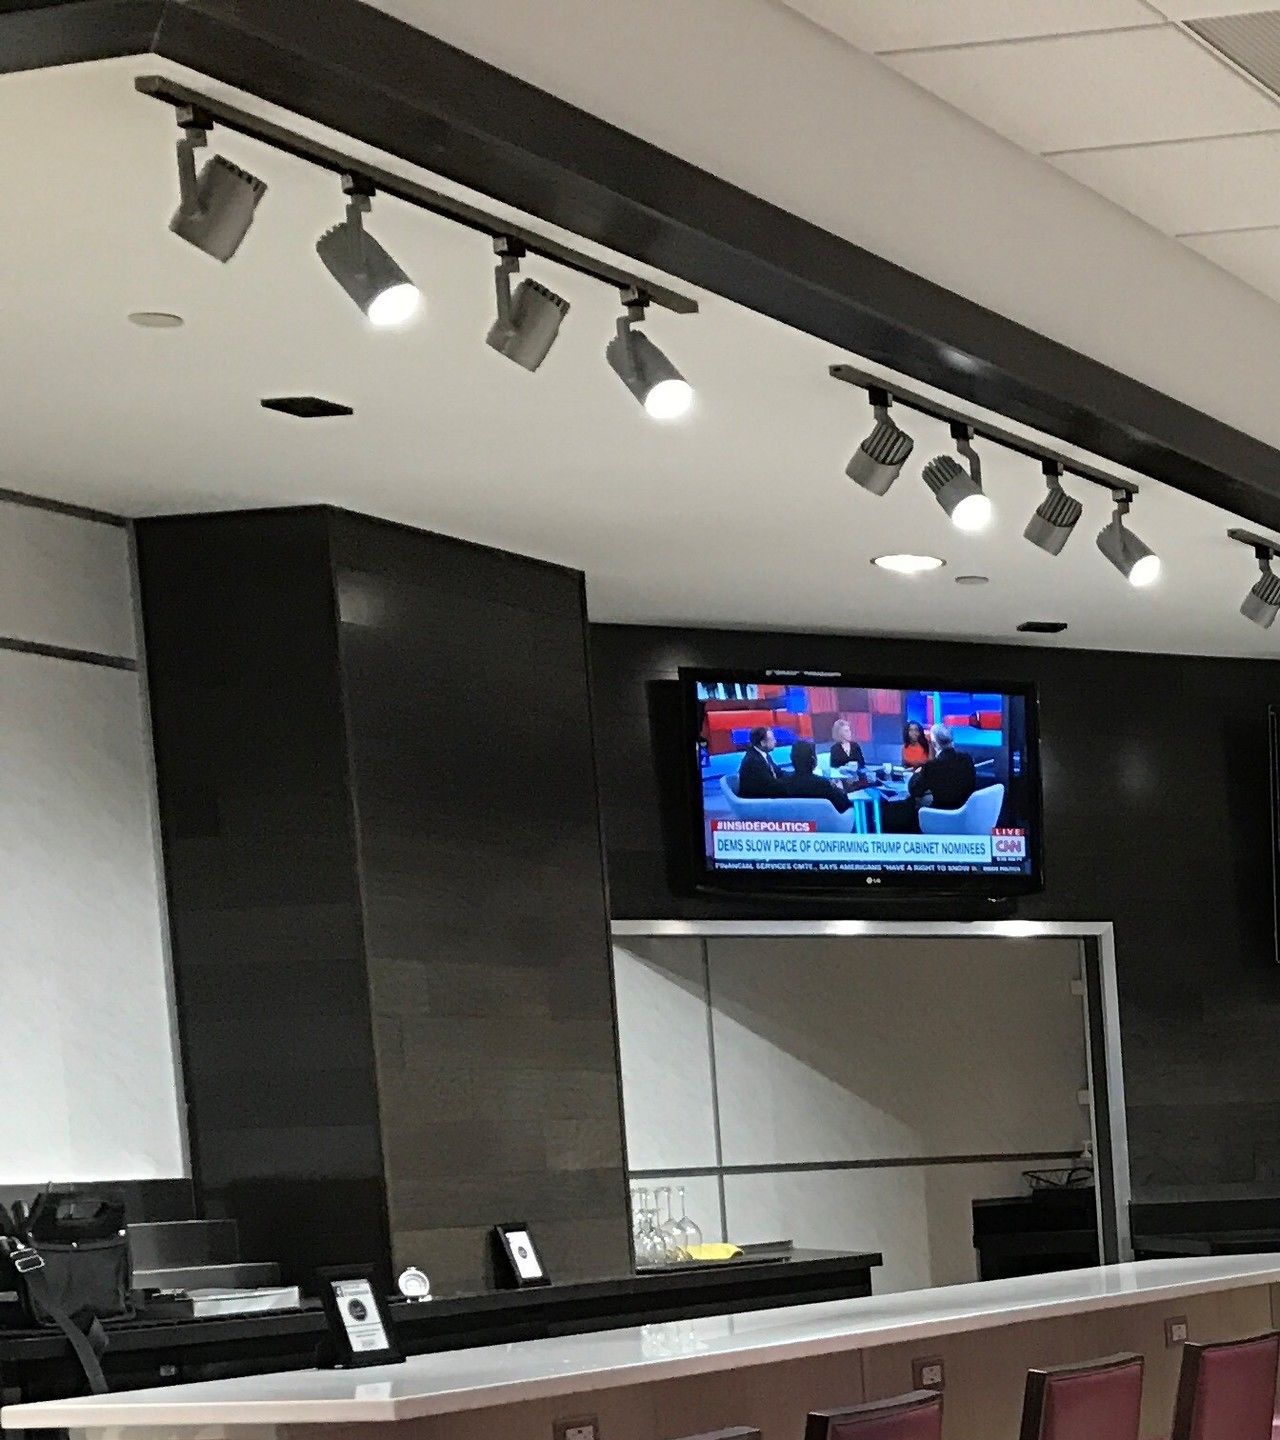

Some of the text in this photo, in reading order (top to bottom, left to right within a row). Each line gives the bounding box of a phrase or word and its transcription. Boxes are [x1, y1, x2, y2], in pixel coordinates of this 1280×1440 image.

[717, 821, 810, 832] #INSIDEPOLITICS
[995, 828, 1021, 836] LIVE
[718, 838, 985, 856] DEMS SLOW PACE OF CONFIRMING TRUMP CABINET NOMINEES
[996, 840, 1021, 852] CNN
[819, 863, 838, 871] SAYS
